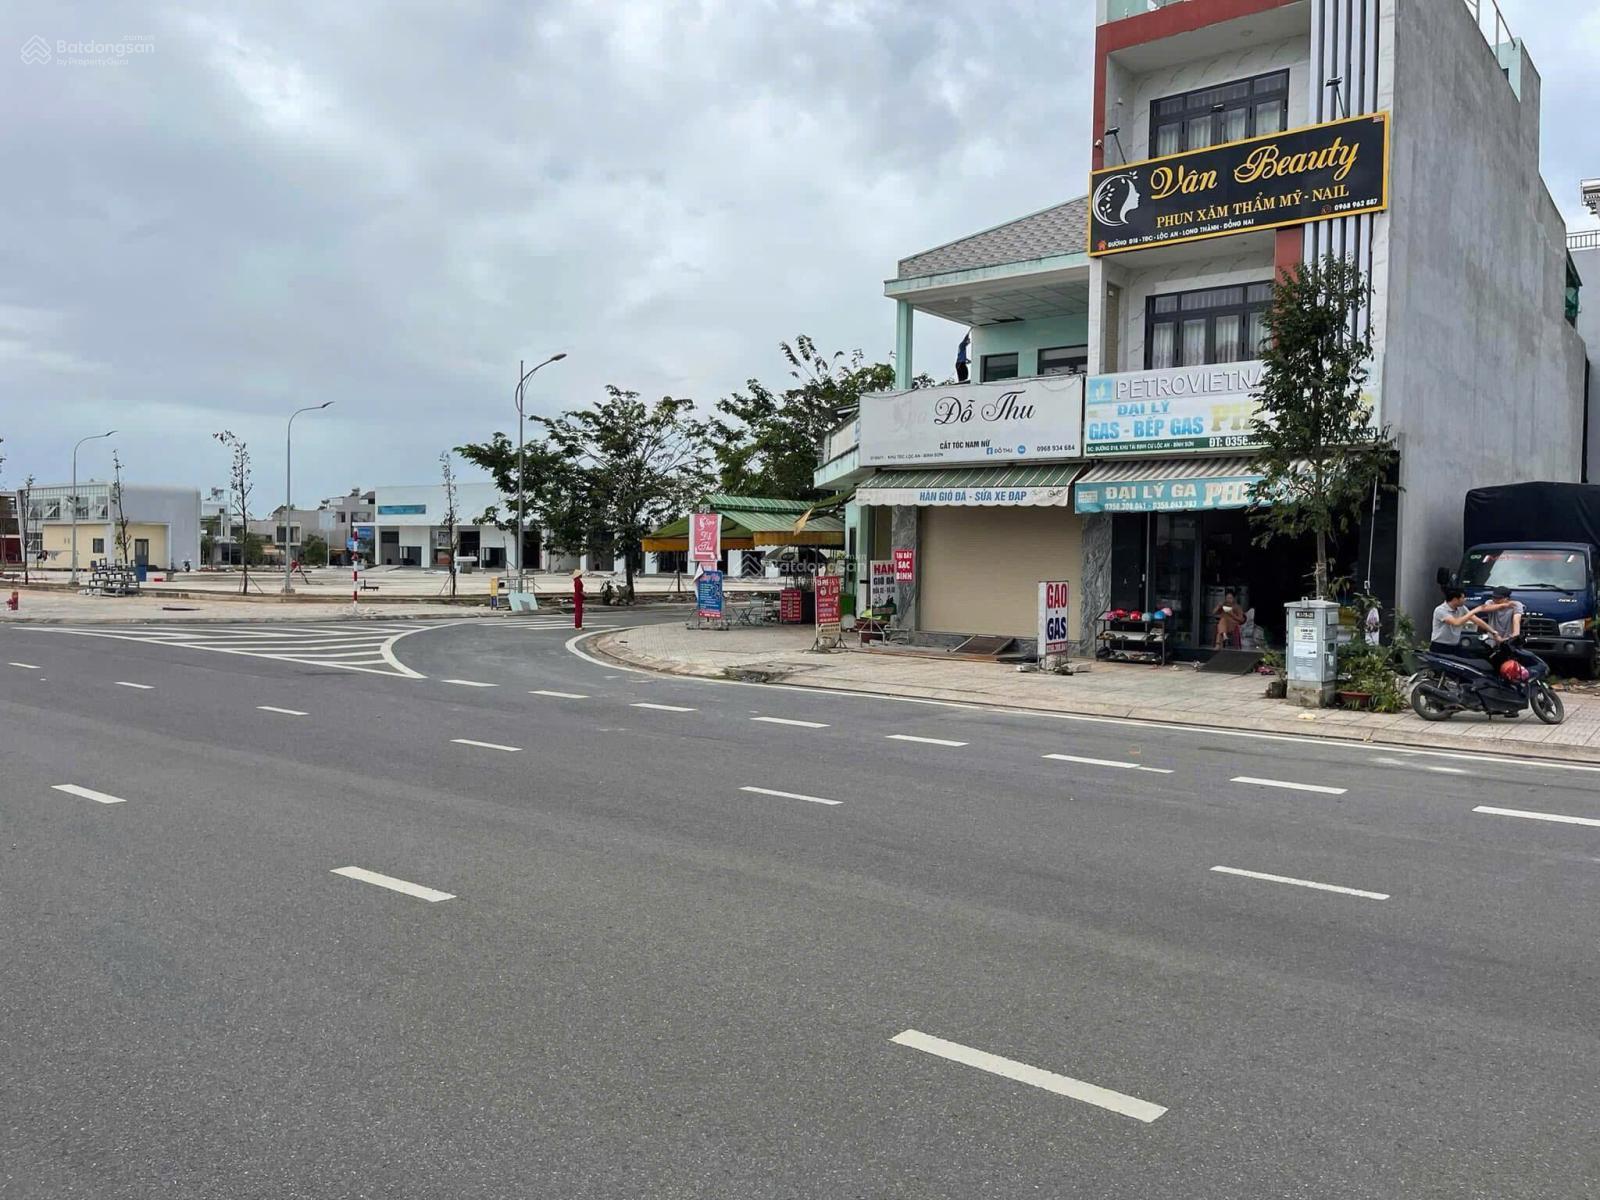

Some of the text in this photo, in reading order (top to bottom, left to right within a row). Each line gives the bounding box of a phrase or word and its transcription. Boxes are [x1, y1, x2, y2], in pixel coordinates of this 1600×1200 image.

[1150, 136, 1360, 200] Vân Beauty
[1156, 211, 1194, 228] PHUN
[1196, 203, 1230, 220] XĂM
[1232, 191, 1276, 215] THẨM
[1280, 190, 1303, 208] MỸ
[1312, 184, 1349, 204] NAIL
[1182, 228, 1198, 236] LONG
[980, 390, 1036, 422] Thu
[1150, 400, 1170, 414] LÝ
[1088, 422, 1120, 440] GAS
[1133, 415, 1164, 438] BẾP
[1170, 416, 1204, 436] GAS
[995, 491, 1006, 500] XE
[1106, 486, 1136, 502] ĐẠI
[1142, 482, 1165, 498] LÝ
[1047, 616, 1066, 640] GAS
